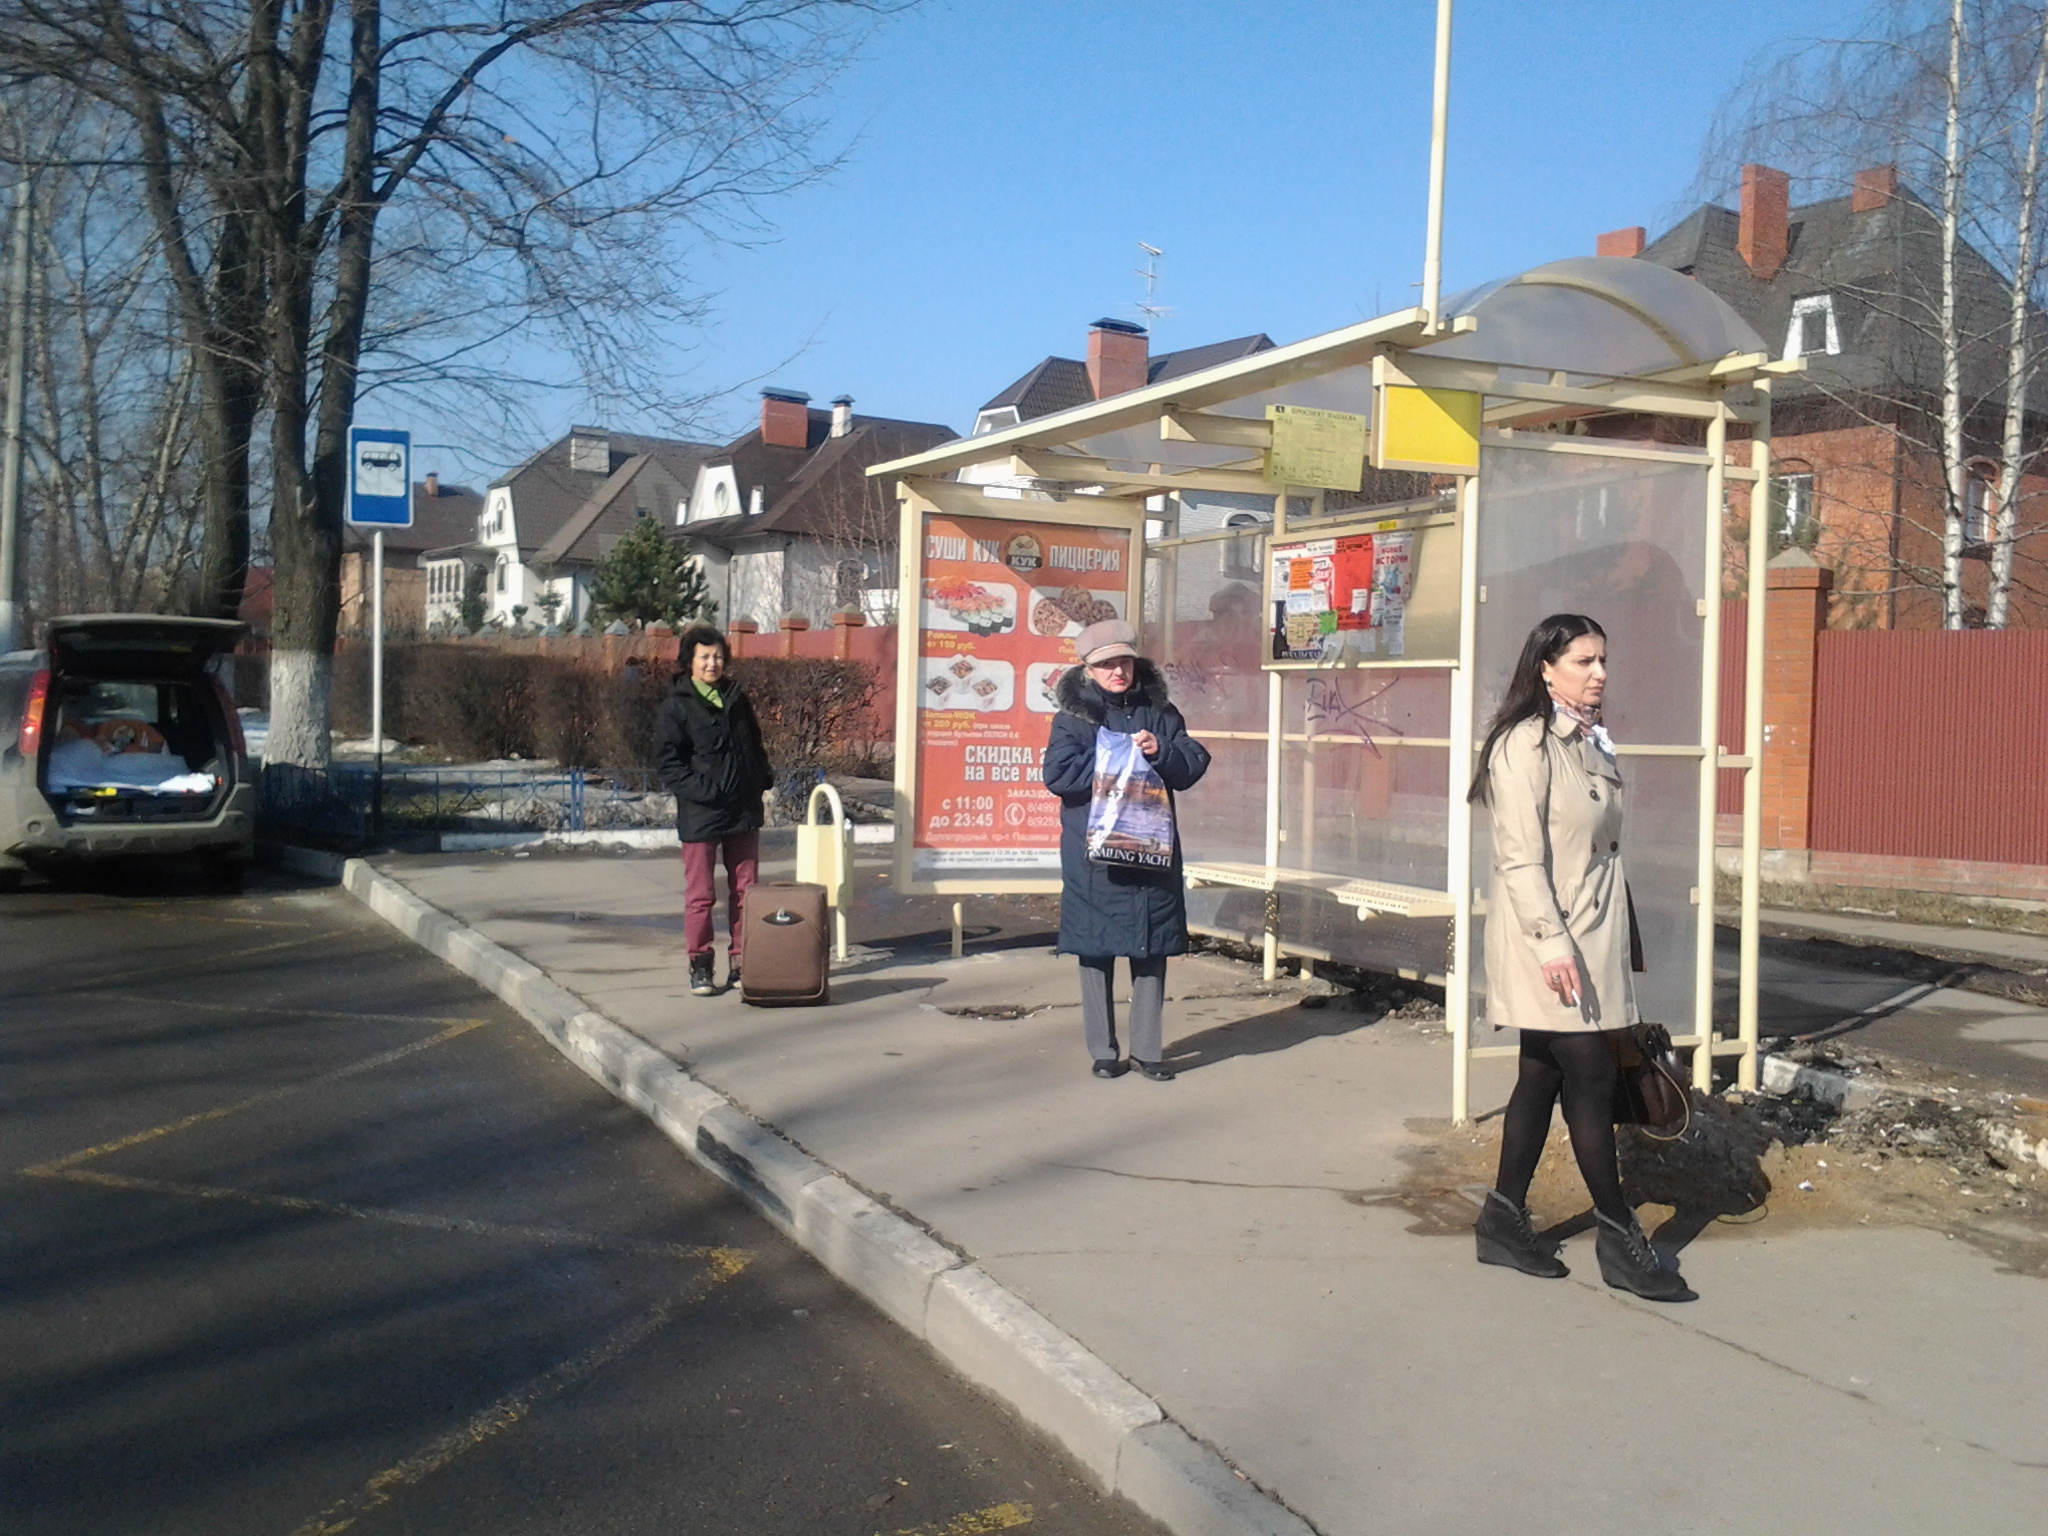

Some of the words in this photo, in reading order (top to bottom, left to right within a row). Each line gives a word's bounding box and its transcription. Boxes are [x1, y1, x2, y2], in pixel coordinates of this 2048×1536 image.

[926, 535, 966, 561] СУШИ
[1011, 556, 1037, 567] КУК
[1049, 545, 1121, 572] ПИЦЦЕРИЯ
[939, 640, 955, 649] 150
[964, 745, 1034, 766] СКИДКА
[964, 765, 985, 781] на
[990, 766, 1020, 782] все
[942, 798, 951, 810] с
[955, 796, 994, 810] 11:00
[1027, 802, 1061, 814] 8(499)
[929, 814, 951, 829] до
[953, 813, 994, 827] 23:45
[1027, 816, 1061, 828] 8(925)
